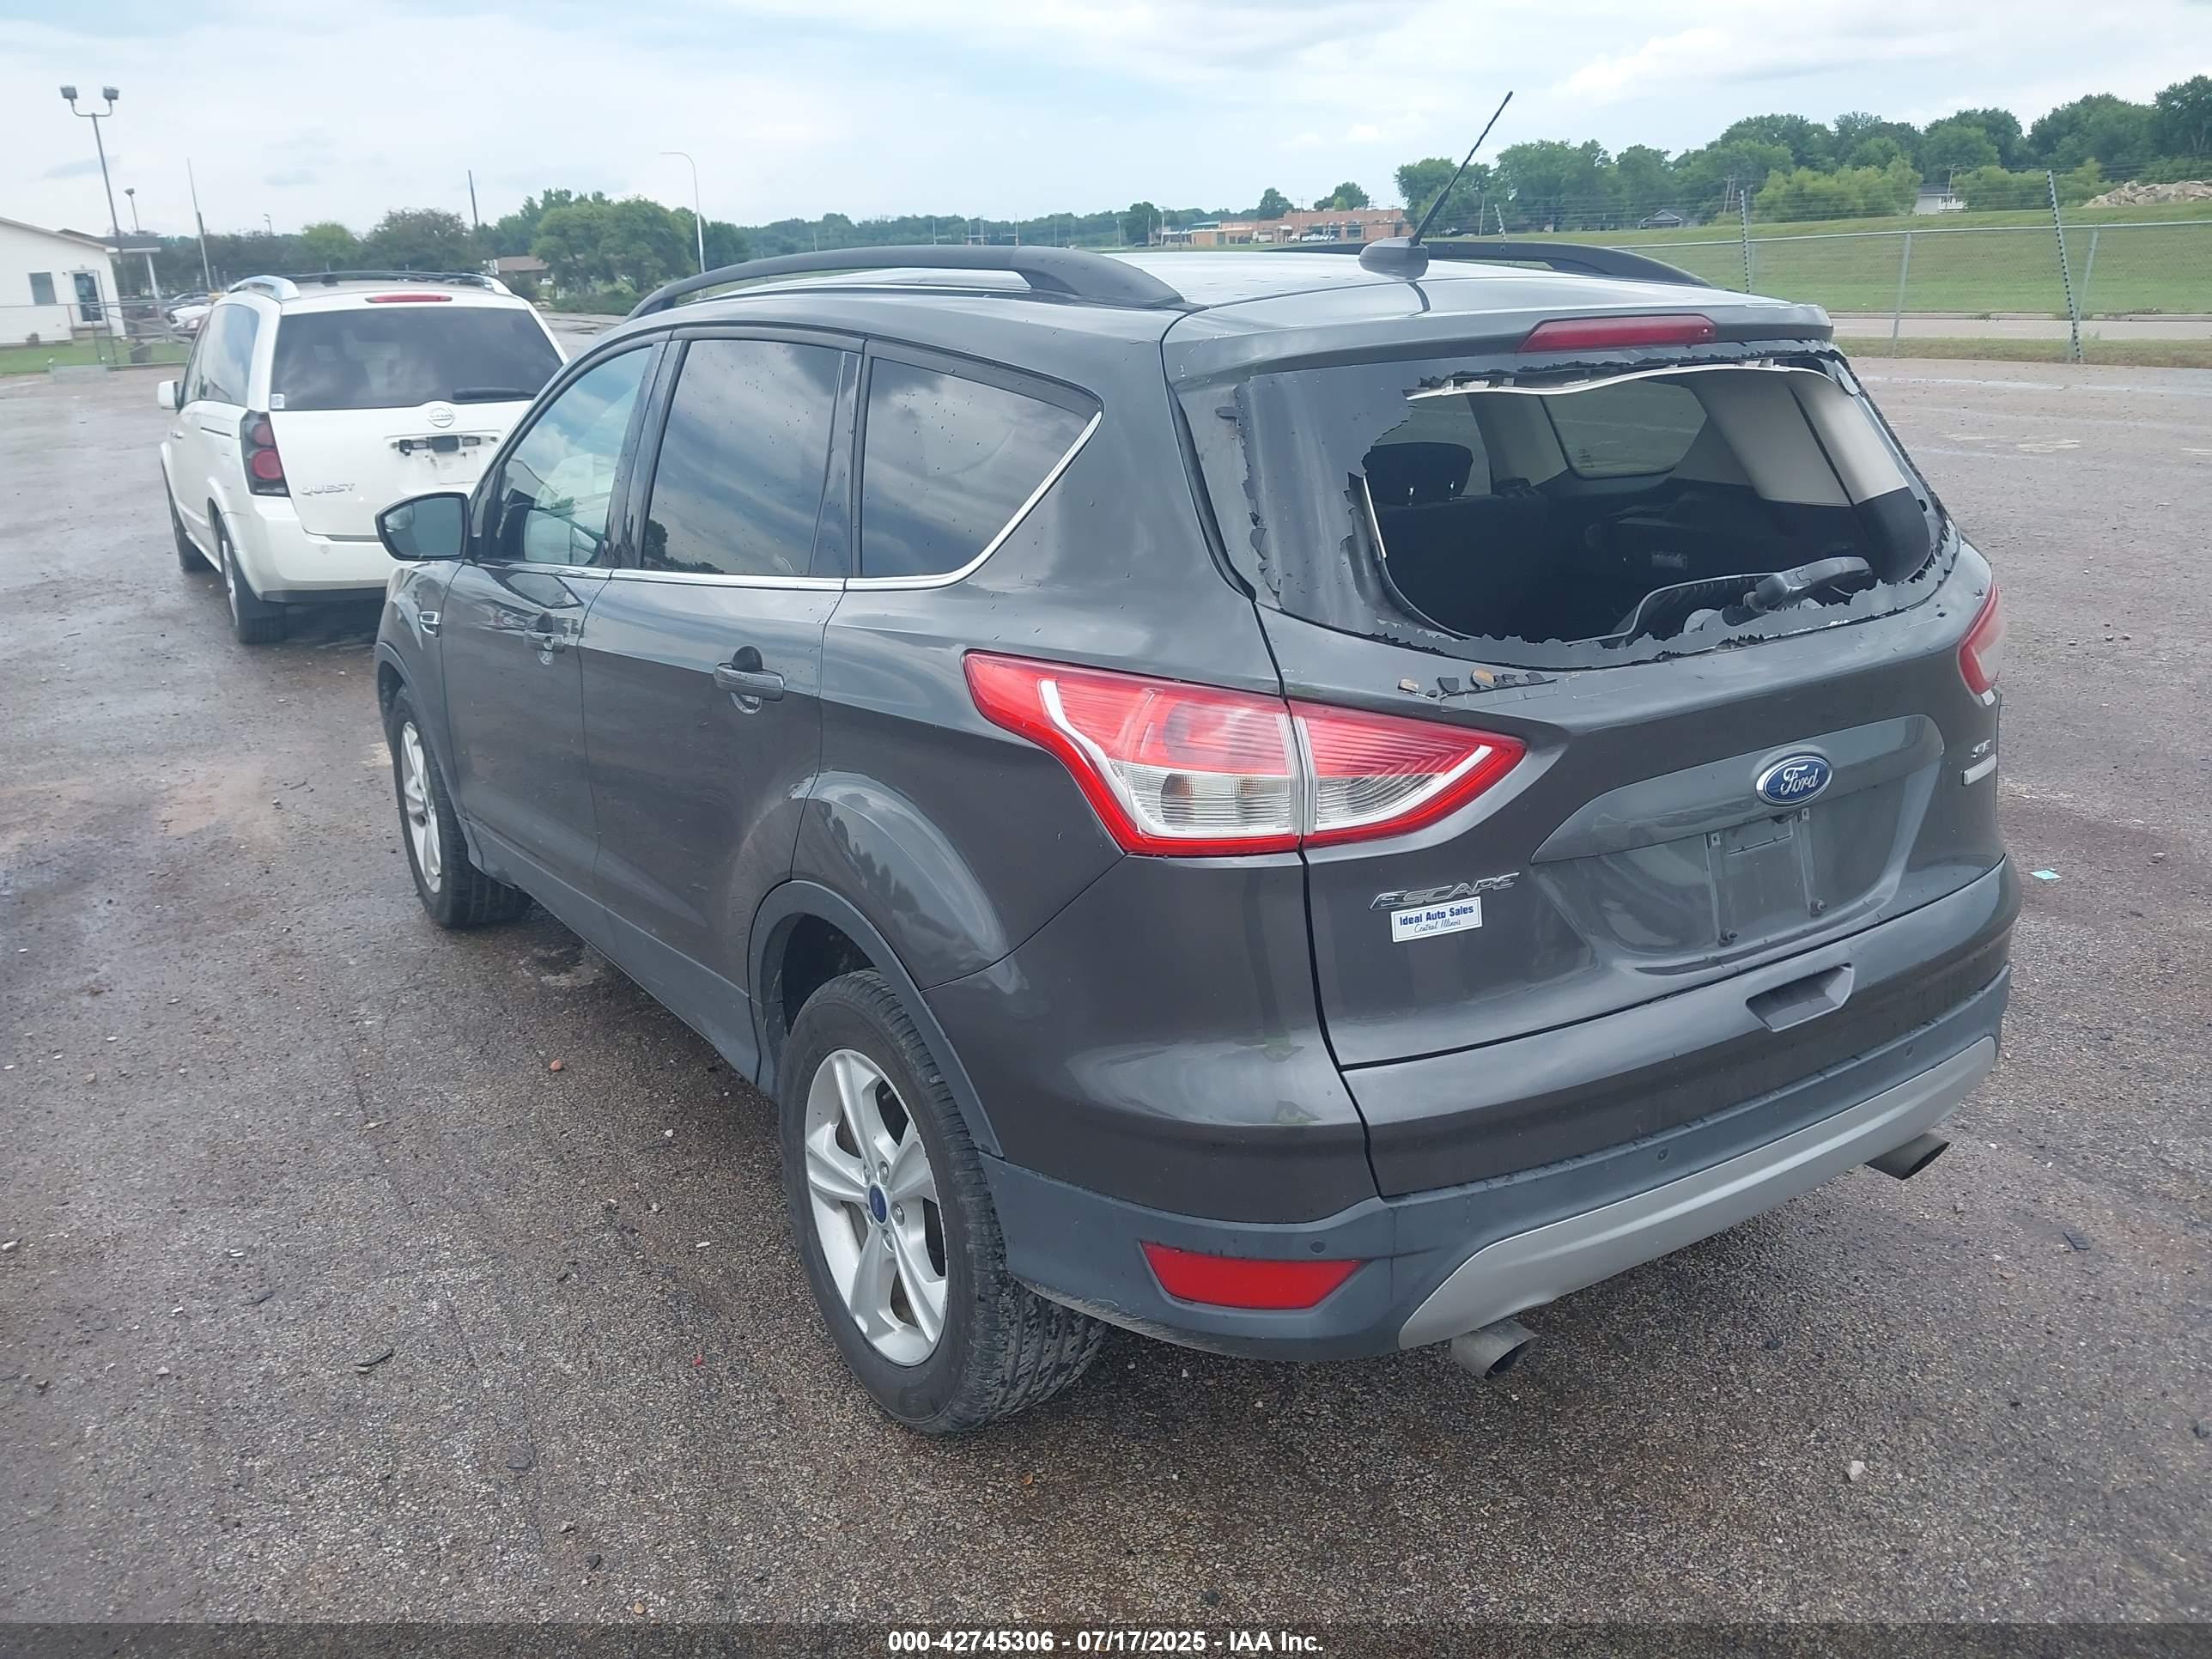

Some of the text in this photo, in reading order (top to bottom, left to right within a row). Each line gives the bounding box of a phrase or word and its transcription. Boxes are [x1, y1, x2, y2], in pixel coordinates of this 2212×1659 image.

[300, 483, 356, 496] QUEST
[1780, 763, 1819, 796] Ford
[1369, 872, 1520, 911] ESCAPE
[1399, 905, 1474, 927] Ideal Auto Sales
[1414, 921, 1437, 933] Central
